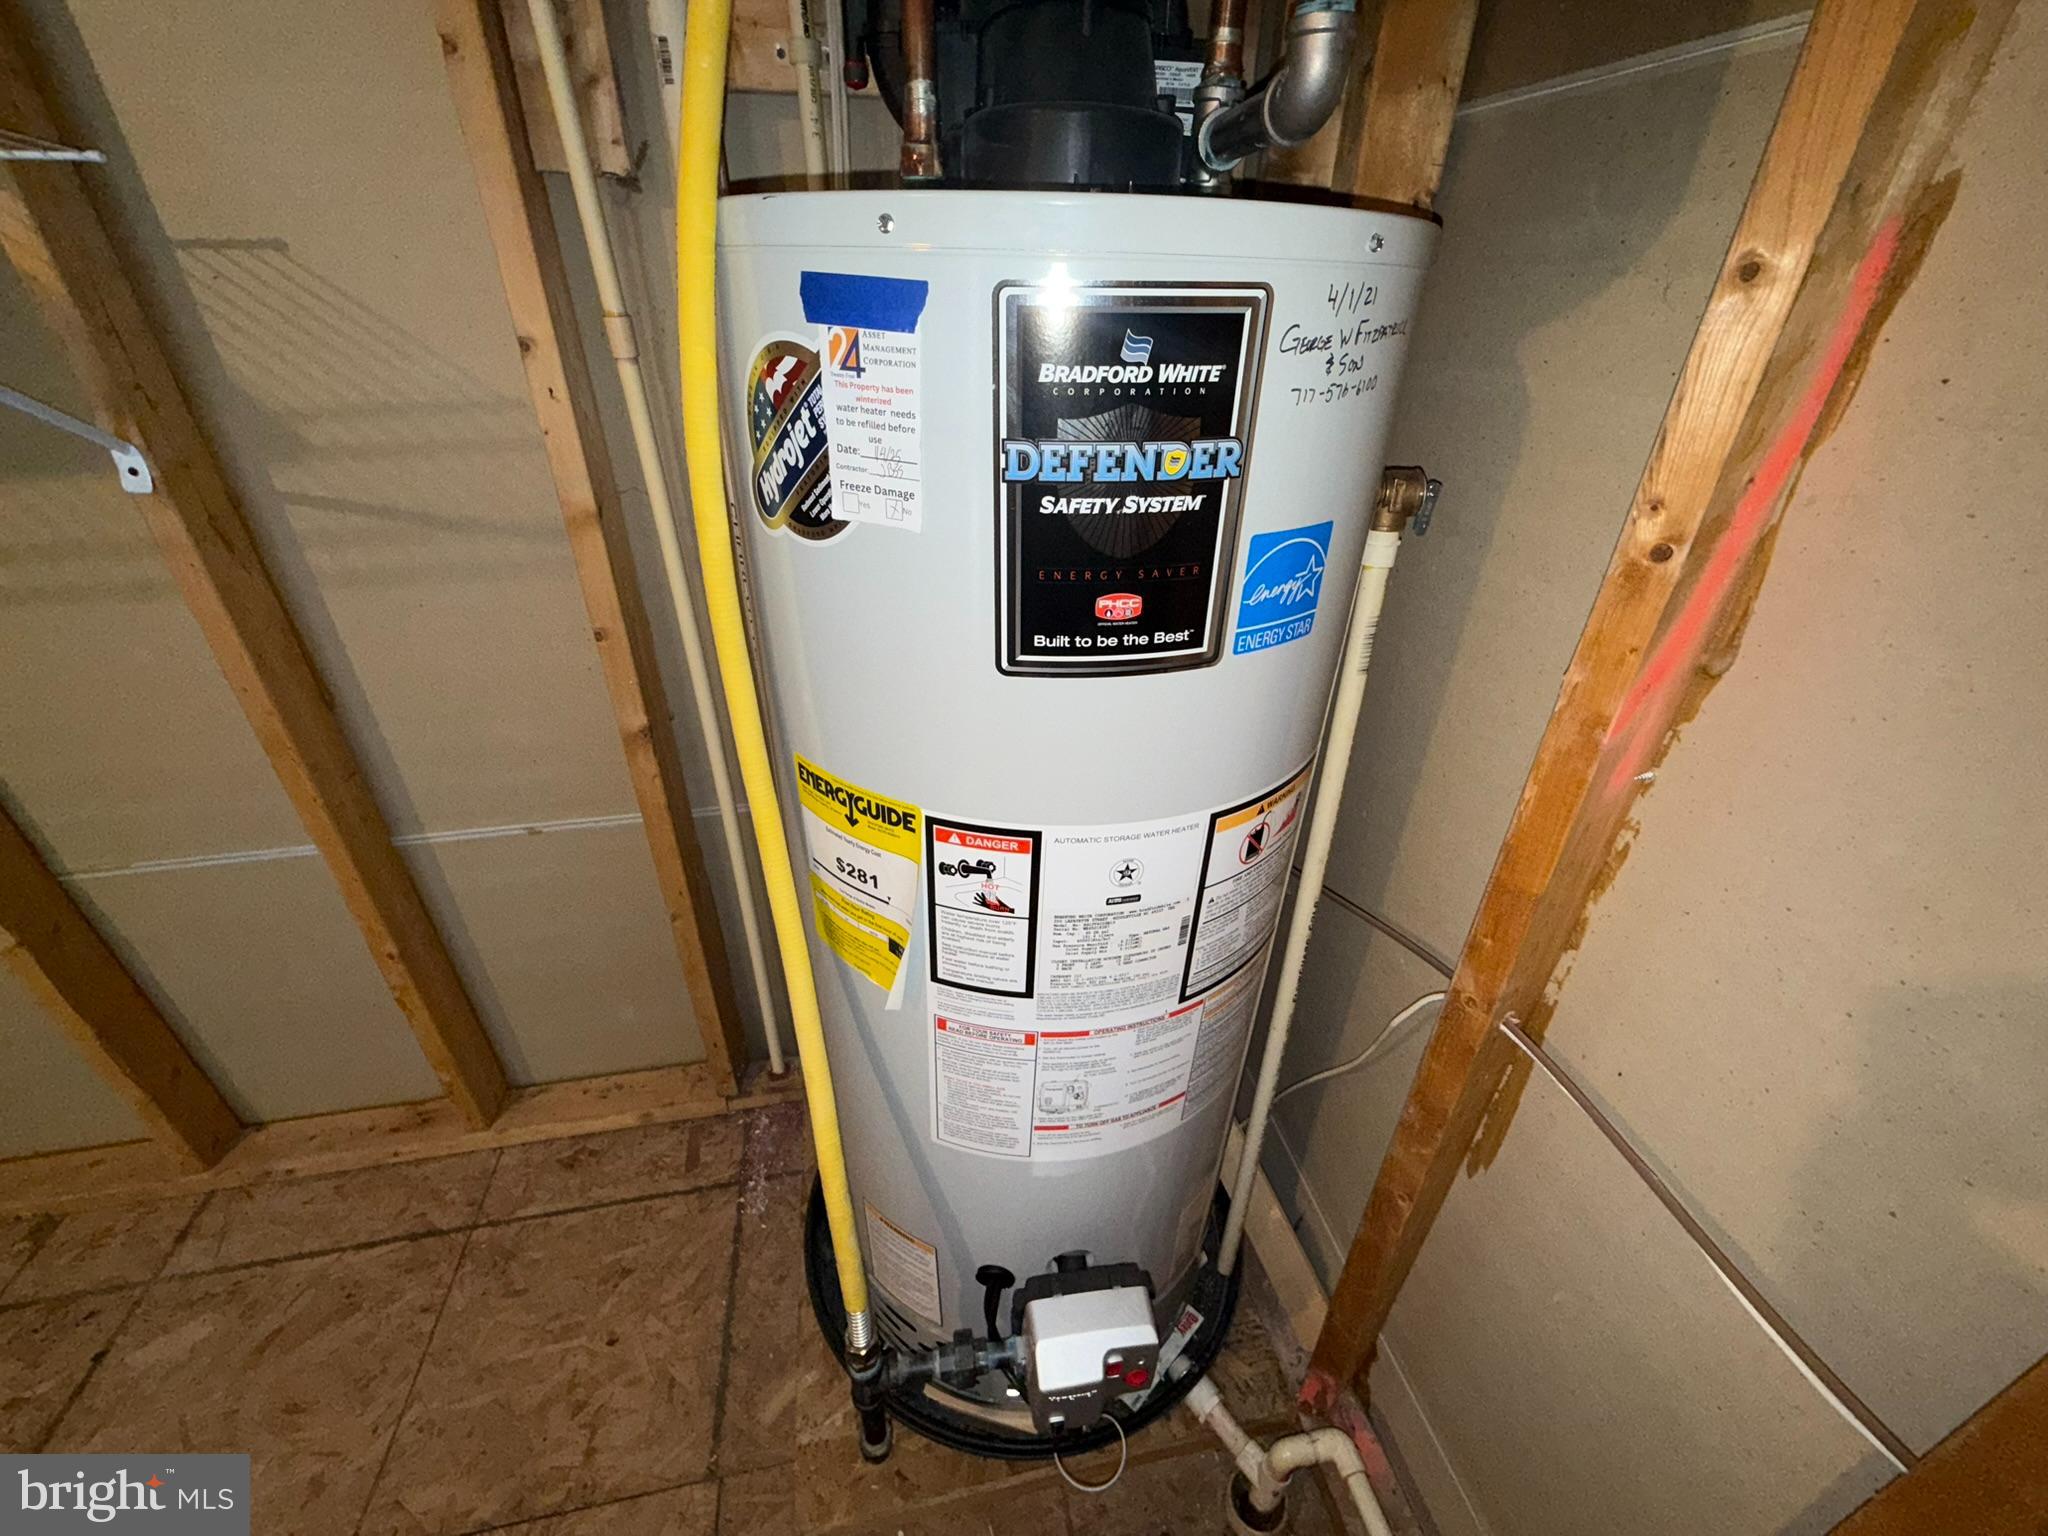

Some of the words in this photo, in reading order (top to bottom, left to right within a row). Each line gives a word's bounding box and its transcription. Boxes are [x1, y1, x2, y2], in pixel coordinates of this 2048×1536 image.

[1328, 281, 1377, 317] 4/1/21
[862, 330, 886, 339] ASSET
[1340, 327, 1353, 349] W
[862, 343, 917, 355] MANAGEMENT
[863, 357, 917, 368] CORPORATION
[1038, 364, 1153, 383] BRADFORD
[834, 380, 848, 389] This
[849, 382, 880, 393] Property
[881, 385, 894, 394] has
[895, 386, 914, 395] been
[1052, 387, 1206, 396] CORPORATION
[856, 395, 892, 405] winterized
[836, 404, 858, 414] water
[860, 406, 887, 416] heater
[890, 410, 916, 420] needs
[836, 417, 845, 425] to
[846, 418, 856, 427] be
[858, 420, 886, 431] refilled
[888, 423, 916, 434] before
[868, 436, 882, 444] use
[836, 443, 860, 456] Date:
[1002, 439, 1243, 484] DEFENDER
[839, 480, 872, 492] Freeze
[874, 485, 915, 501] Damage
[1039, 496, 1117, 514] SAFETY
[1038, 569, 1123, 581] ENERGY
[1138, 565, 1201, 579] SAVER
[1249, 576, 1302, 606] energy
[1098, 599, 1140, 608] PHCC
[1033, 634, 1070, 648] Built
[1075, 635, 1092, 647] to
[1097, 635, 1118, 647] be
[1123, 633, 1149, 646] the
[1238, 627, 1285, 652] ENERGY
[1286, 618, 1312, 641] STAR
[798, 761, 917, 833] ENERGYGUIDE
[1266, 785, 1296, 809] WARNING
[1104, 833, 1141, 843] STORAGE
[1143, 829, 1170, 839] WATER
[1171, 823, 1199, 835] HEATER
[966, 835, 1019, 850] DANGER
[836, 857, 878, 889] $281
[981, 882, 999, 891] HOT
[1094, 1026, 1126, 1035] OPERATING
[1127, 1015, 1165, 1030] INSTRUCTIONS
[948, 1026, 963, 1035] READ
[965, 1030, 987, 1039] BEFORE
[989, 1035, 1023, 1043] OPERATING
